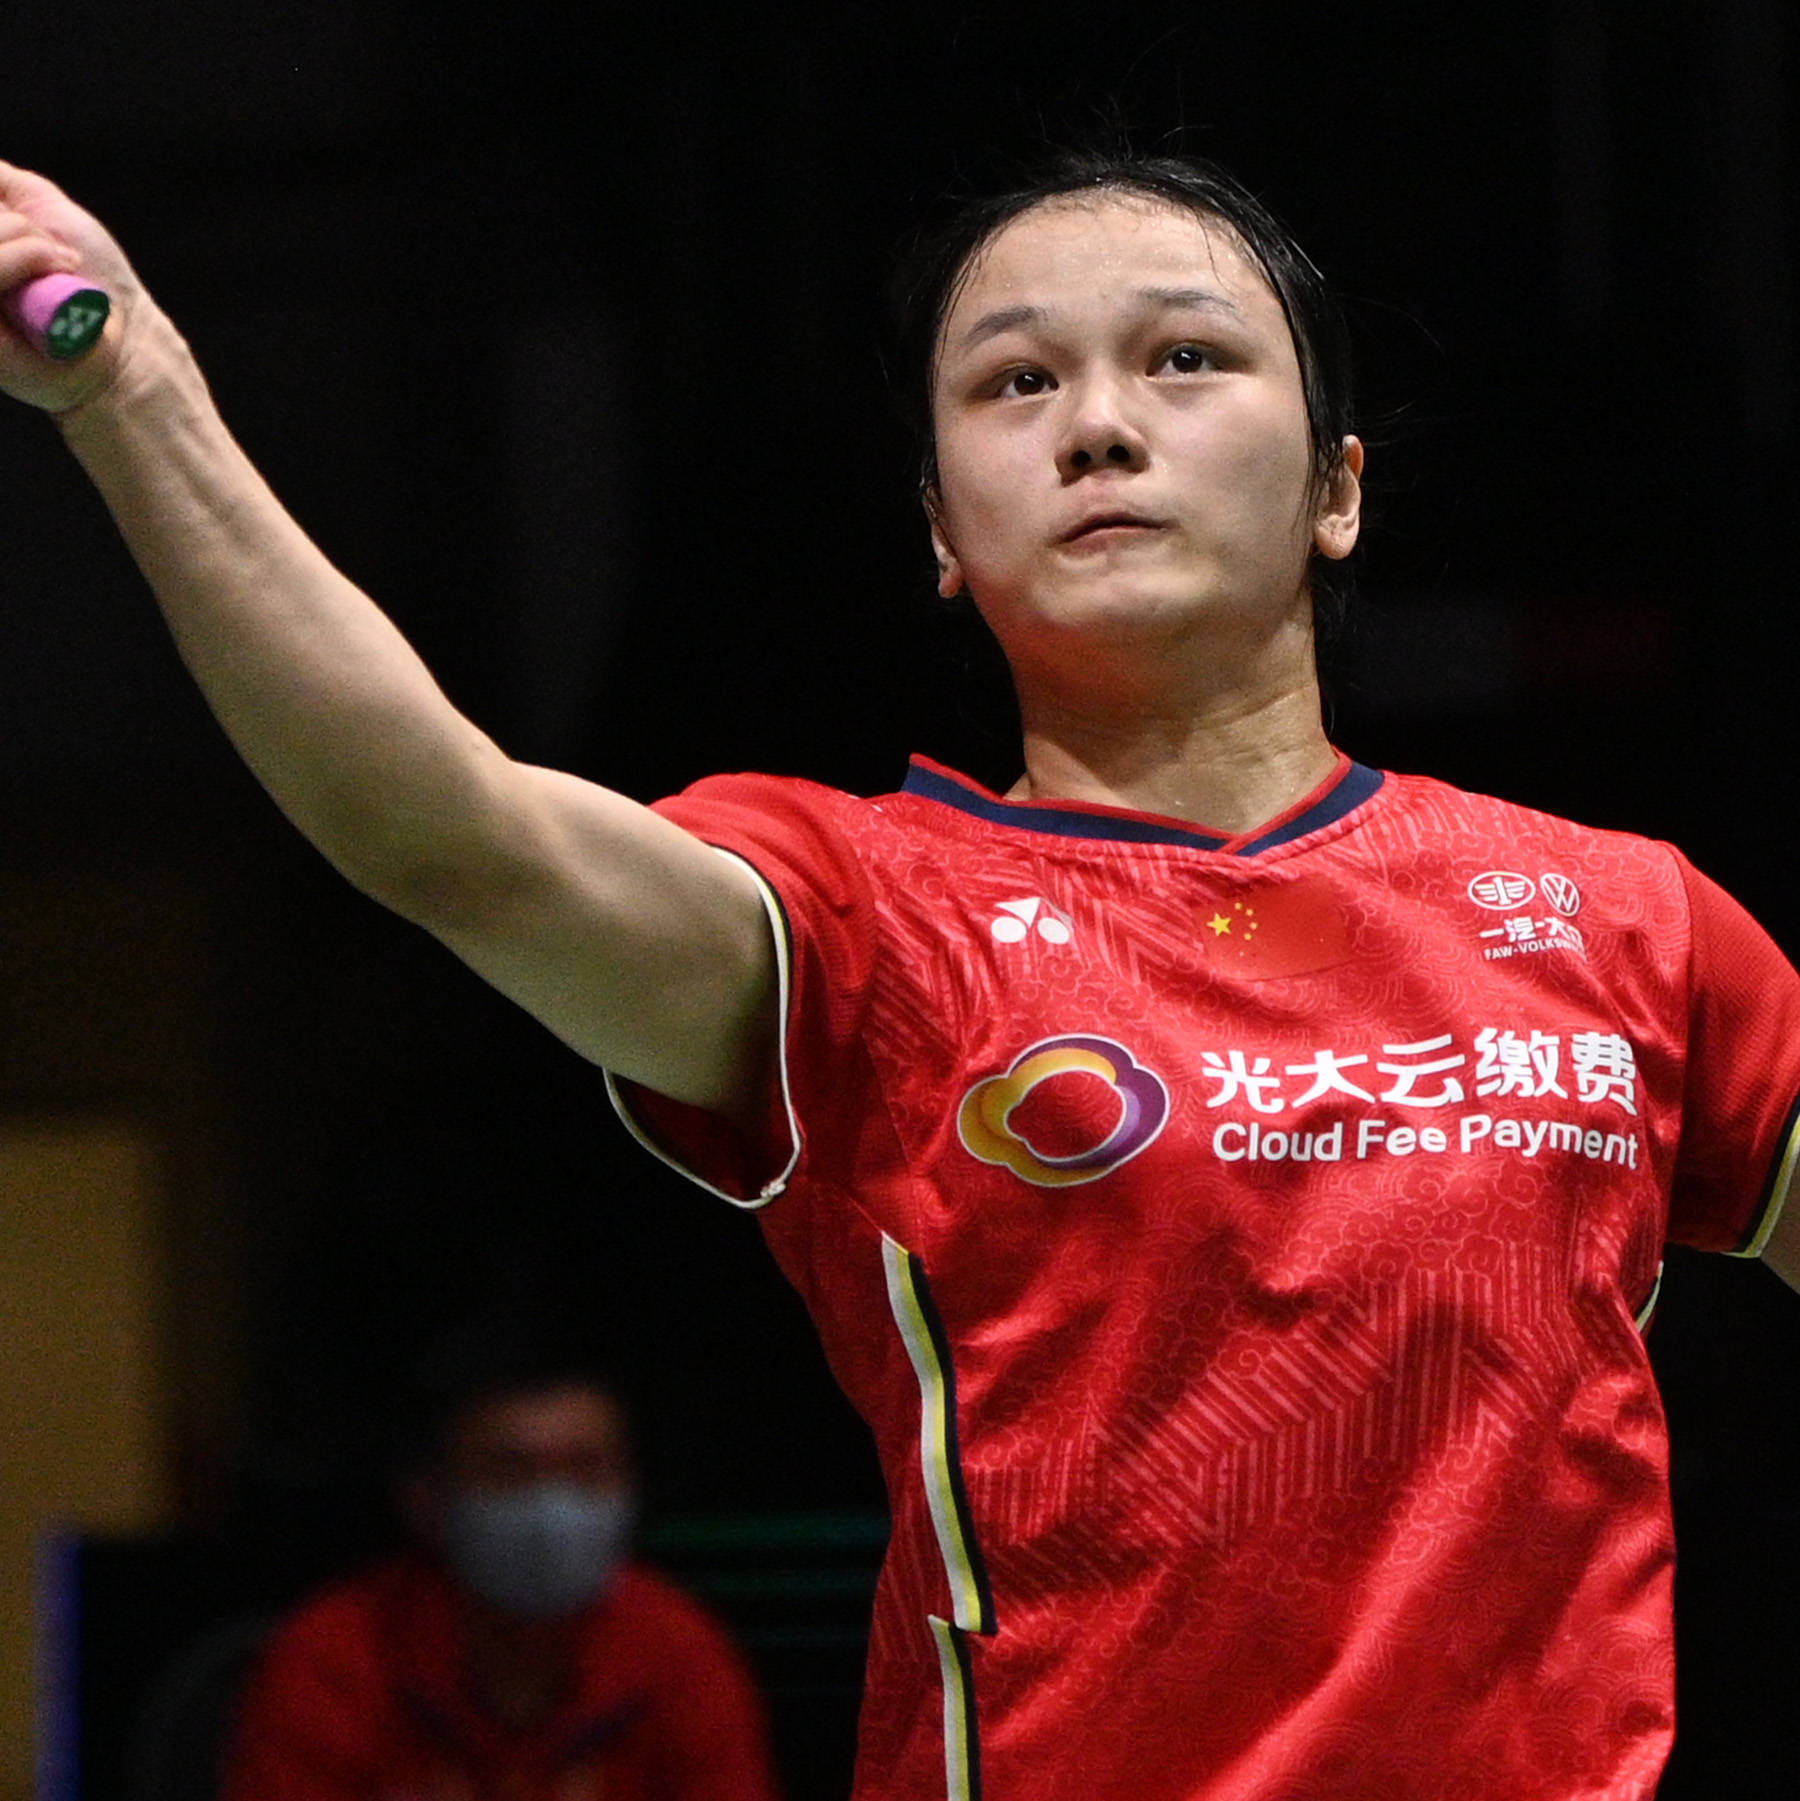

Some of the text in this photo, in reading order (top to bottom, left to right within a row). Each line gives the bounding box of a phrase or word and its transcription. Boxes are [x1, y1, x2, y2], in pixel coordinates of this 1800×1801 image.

[1201, 1028, 1638, 1116] 光大云缴费
[1212, 1114, 1638, 1170] Cloud Fee Payment
